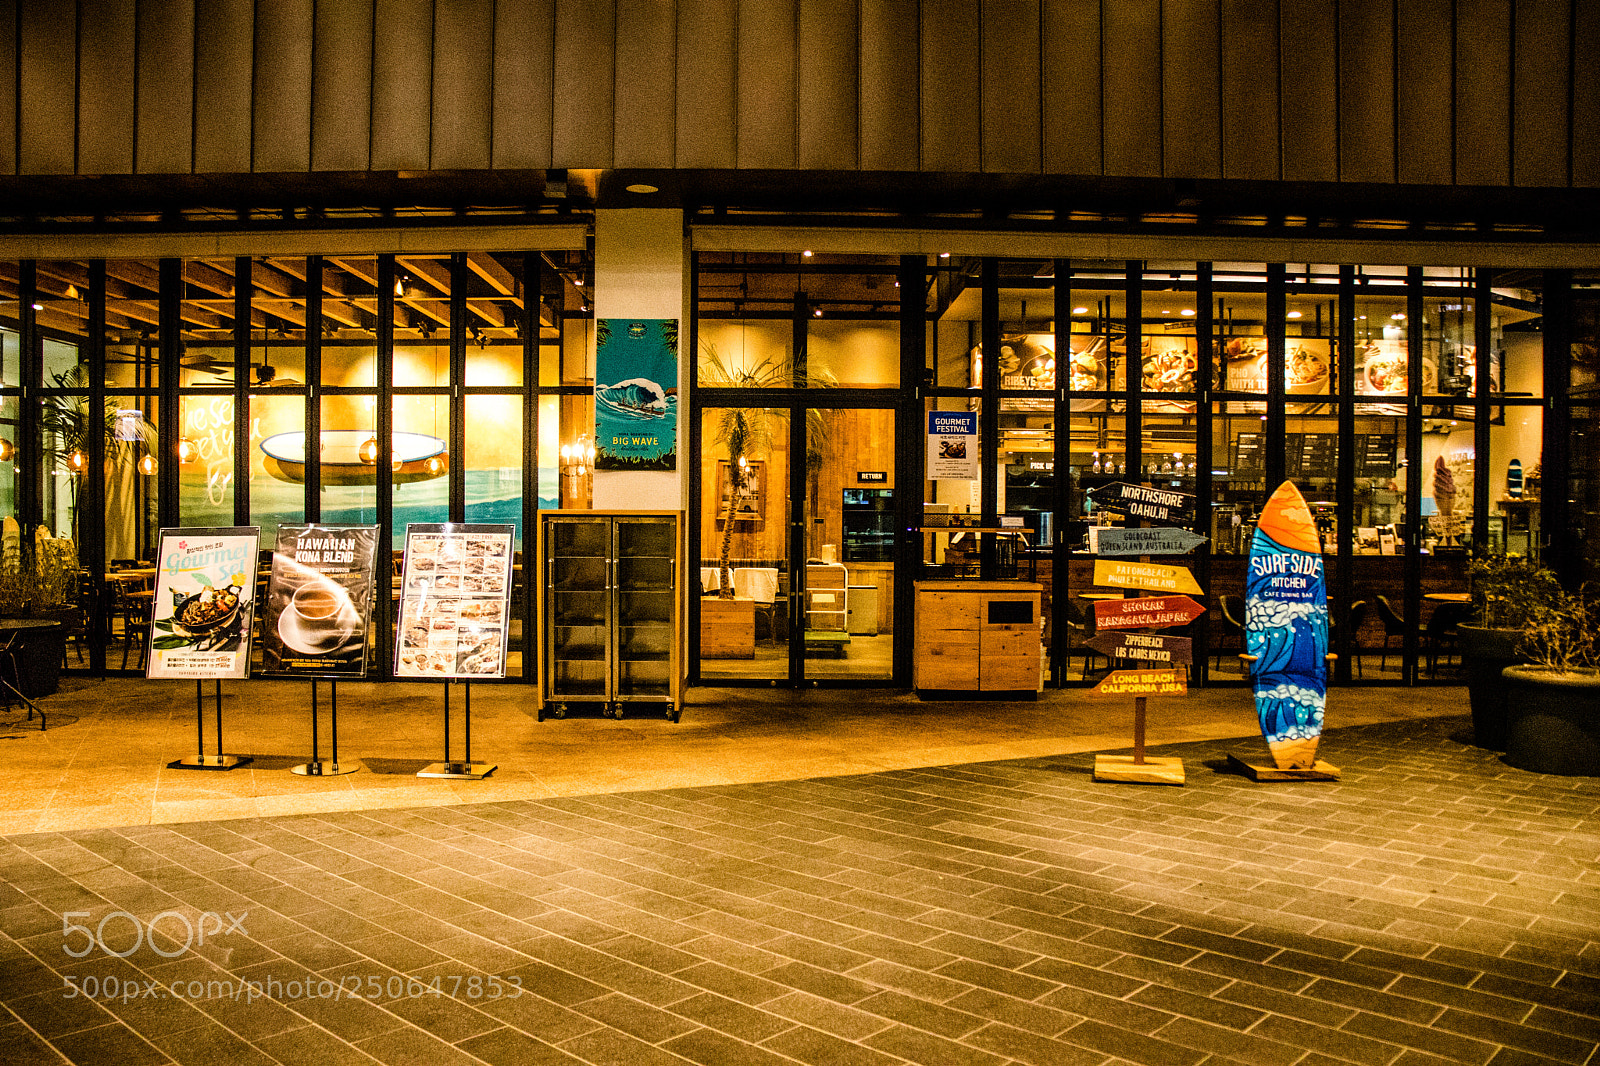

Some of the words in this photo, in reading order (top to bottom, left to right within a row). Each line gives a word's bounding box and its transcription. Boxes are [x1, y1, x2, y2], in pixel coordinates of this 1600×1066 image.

[1004, 375, 1036, 386] RIBEYE
[935, 418, 970, 426] GOURMET
[936, 425, 970, 433] FESTIVAL
[612, 436, 629, 446] BIG
[632, 436, 659, 446] WAVE
[861, 472, 883, 480] RETURN
[1121, 486, 1185, 508] NORTHSHORE
[296, 538, 356, 551] HAWAIIAN
[166, 542, 249, 577] Gourmet
[295, 551, 321, 563] KONA
[322, 551, 354, 563] BLEND
[1251, 553, 1324, 579] SURFSIDE
[1271, 577, 1307, 588] KITCHEN
[1112, 674, 1139, 684] LONG
[1141, 673, 1175, 683] BEACH
[1100, 684, 1158, 694] CALIFORNIA
